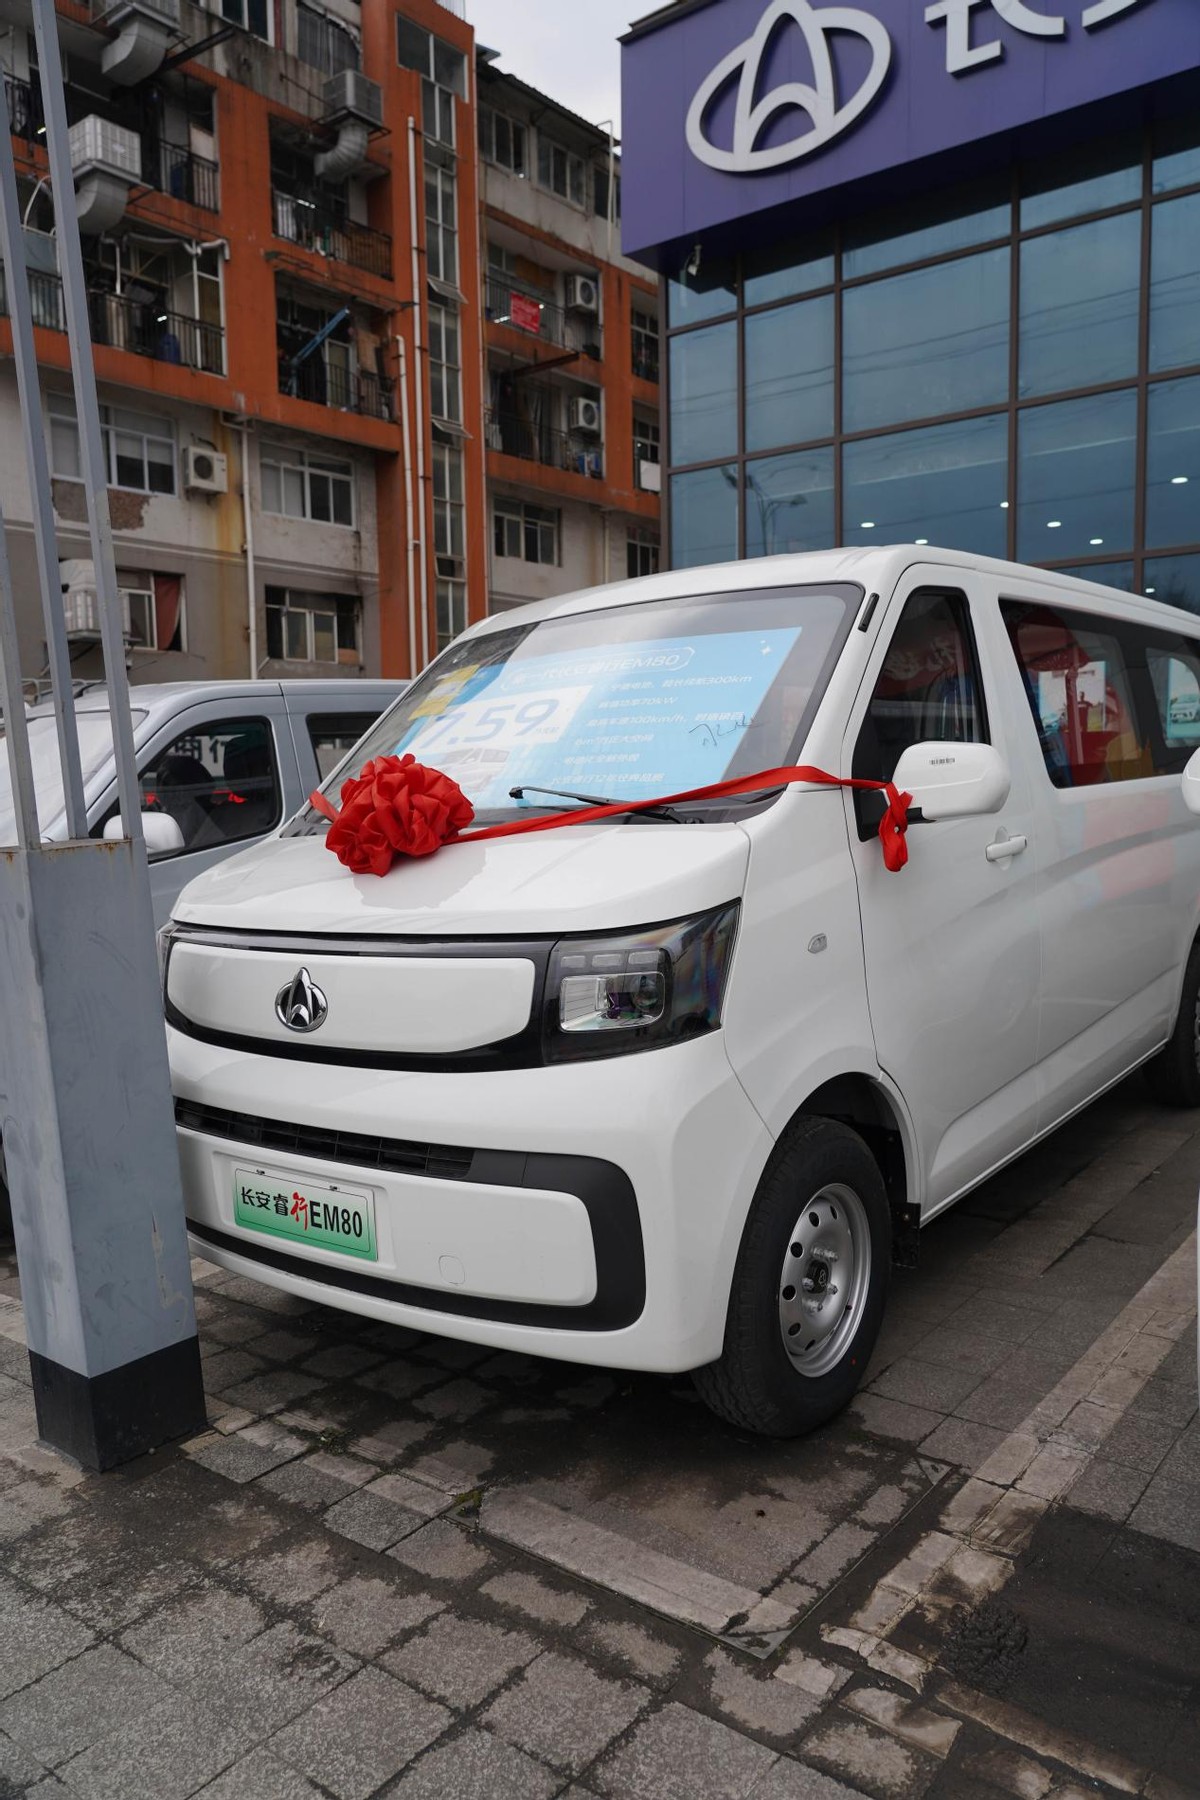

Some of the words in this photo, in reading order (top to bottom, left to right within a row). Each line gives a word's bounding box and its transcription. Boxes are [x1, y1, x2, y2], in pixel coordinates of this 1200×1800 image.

[419, 698, 559, 749] 7.59
[241, 1186, 363, 1238] 长安睿行EM80
